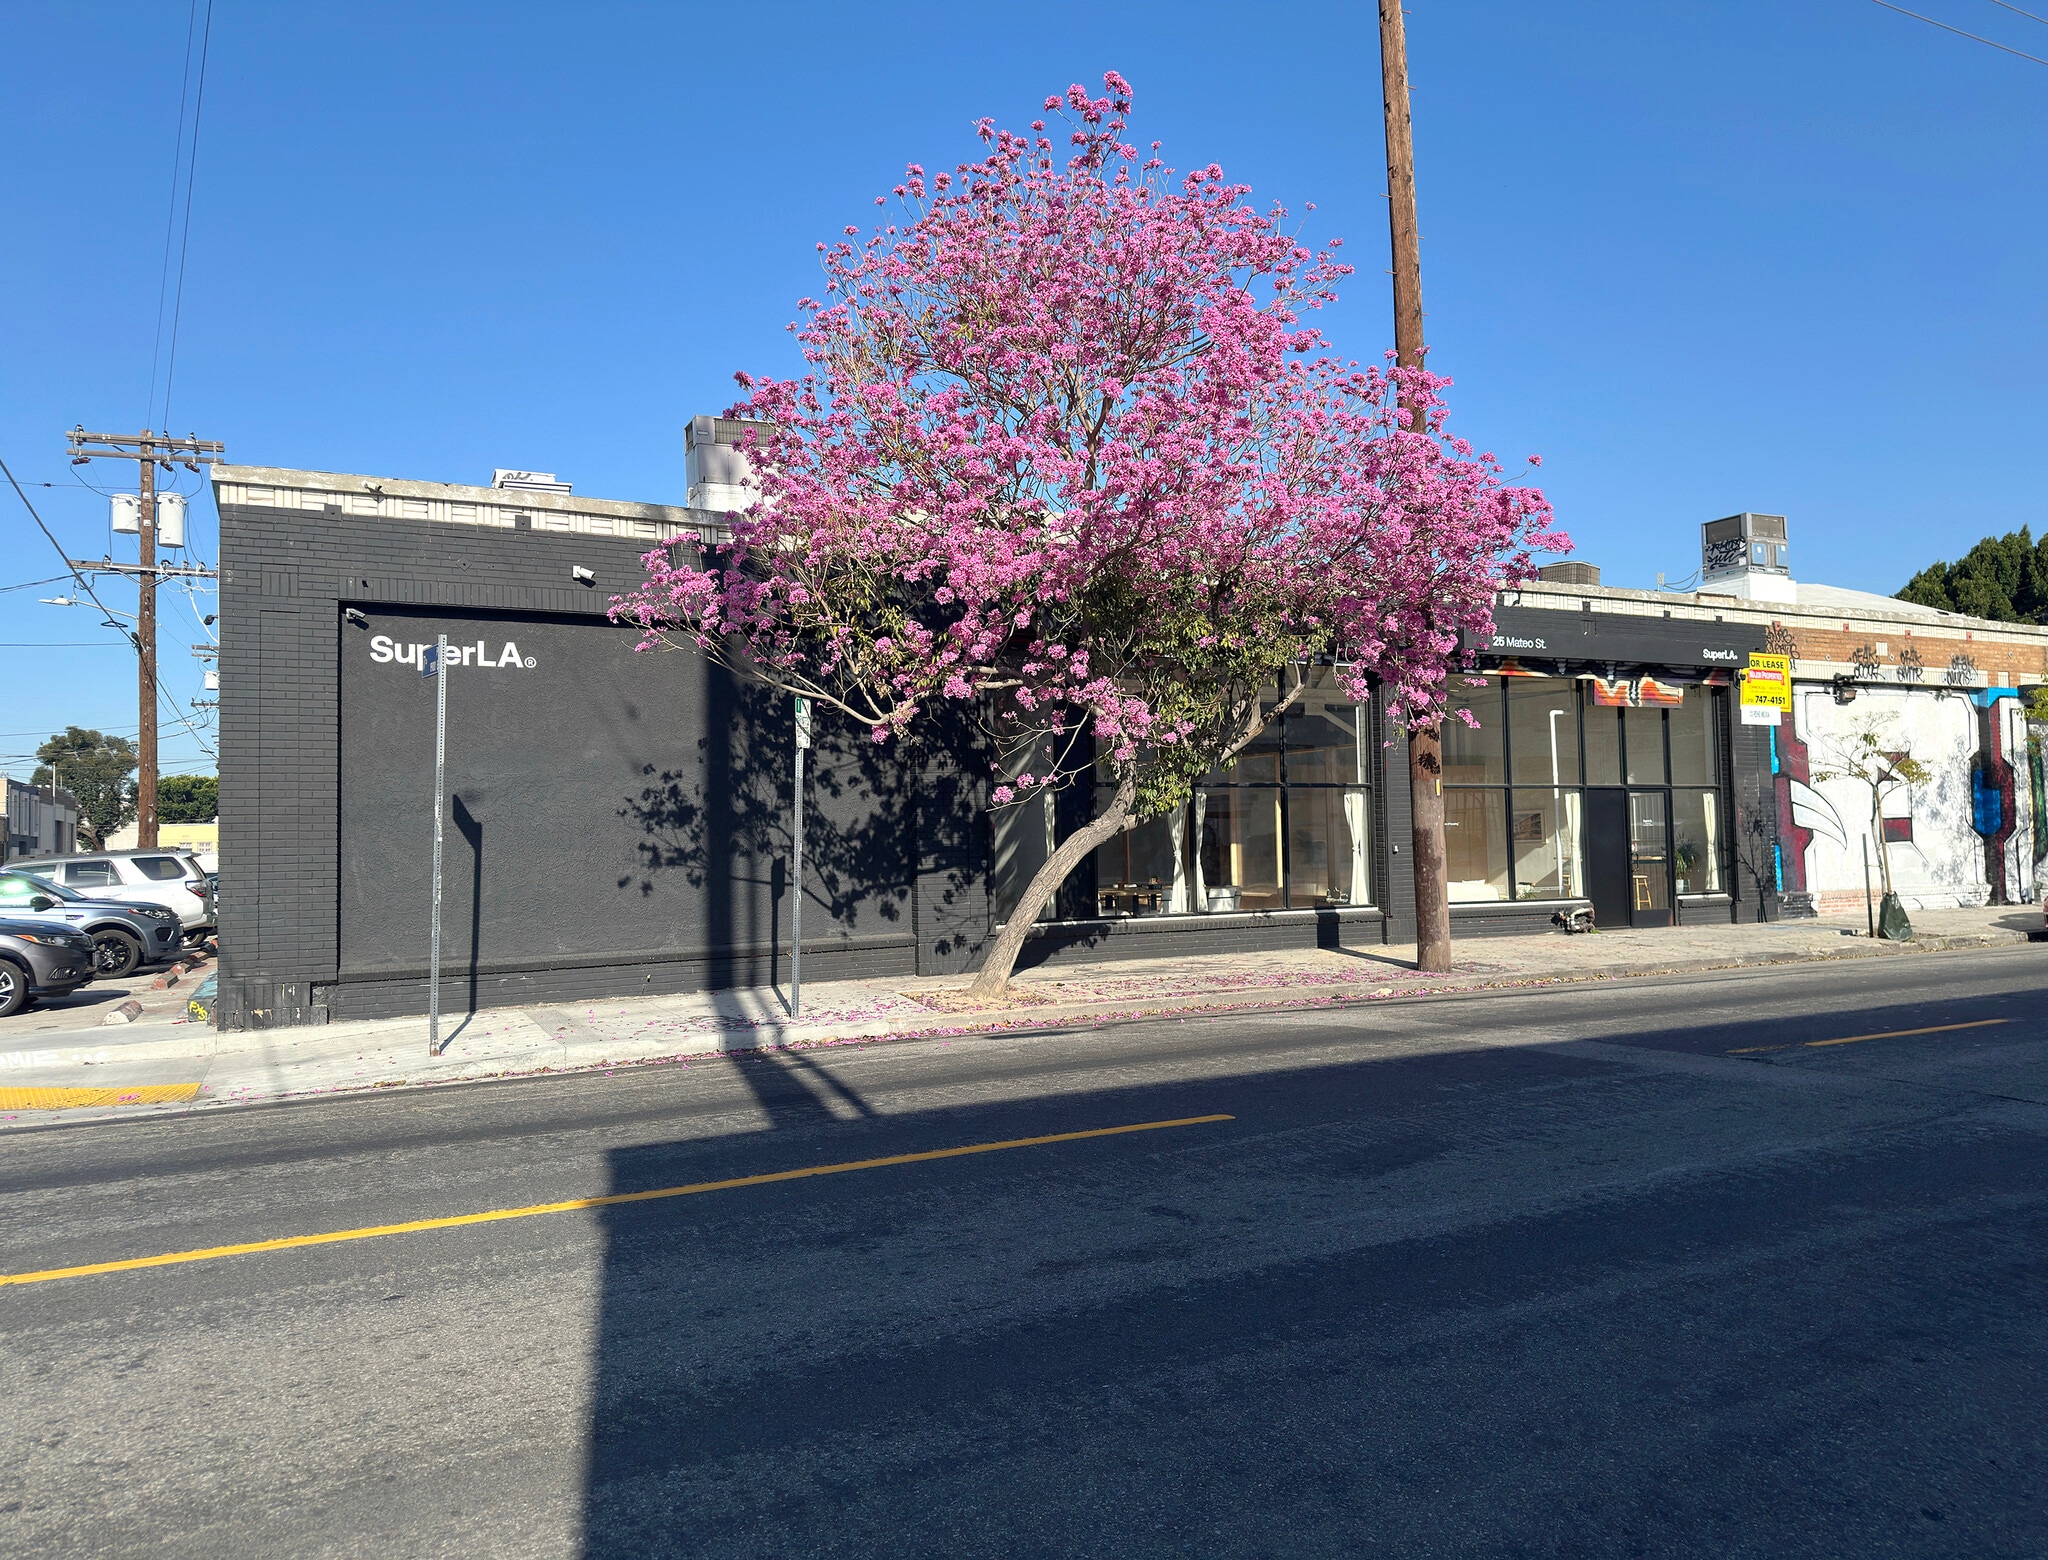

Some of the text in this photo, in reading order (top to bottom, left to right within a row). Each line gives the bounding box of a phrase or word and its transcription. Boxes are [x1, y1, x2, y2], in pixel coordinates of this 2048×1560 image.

[1492, 636, 1547, 649] 25 Mateo St.
[1762, 660, 1784, 669] LEASE
[1755, 695, 1786, 705] 747-4151
